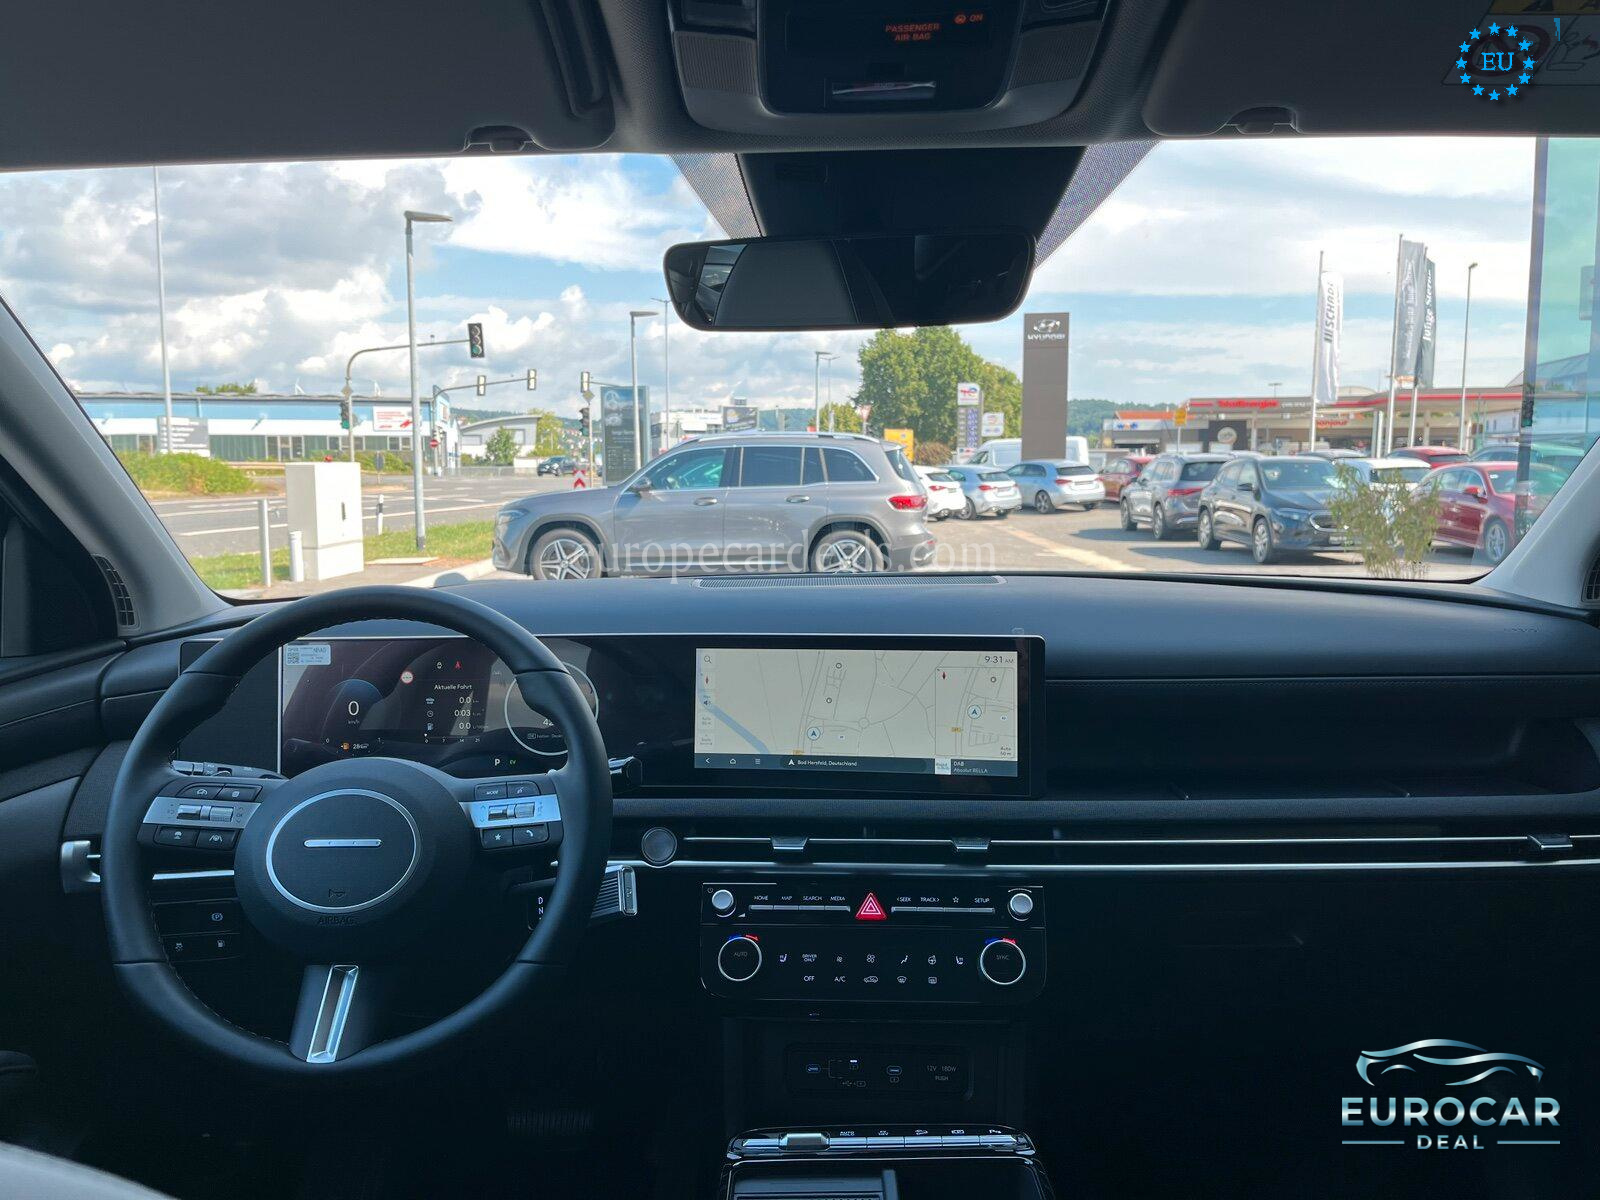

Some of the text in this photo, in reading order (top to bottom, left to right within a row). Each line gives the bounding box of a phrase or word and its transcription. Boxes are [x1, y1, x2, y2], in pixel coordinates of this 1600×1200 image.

[886, 23, 940, 32] PASSENGER
[985, 655, 1003, 664] 9:31
[348, 700, 360, 716] 0
